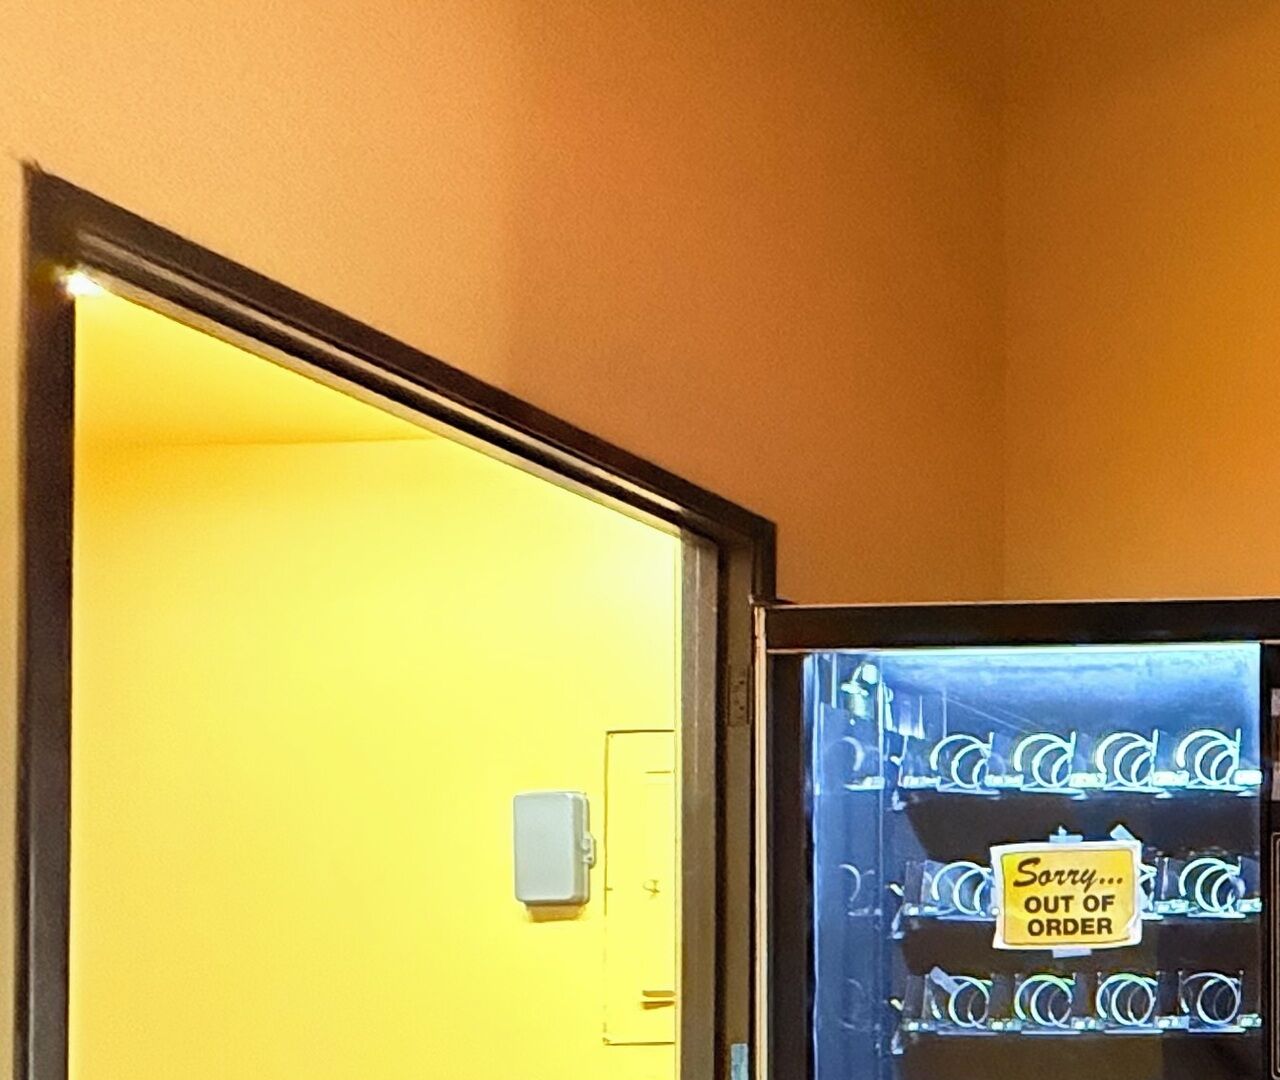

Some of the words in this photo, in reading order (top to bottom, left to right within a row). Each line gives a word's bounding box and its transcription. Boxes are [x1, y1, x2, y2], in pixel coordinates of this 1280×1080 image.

[1013, 857, 1123, 893] Sorry...
[1024, 895, 1075, 914] OUT
[1082, 894, 1116, 912] OF
[1027, 917, 1113, 937] ORDER
